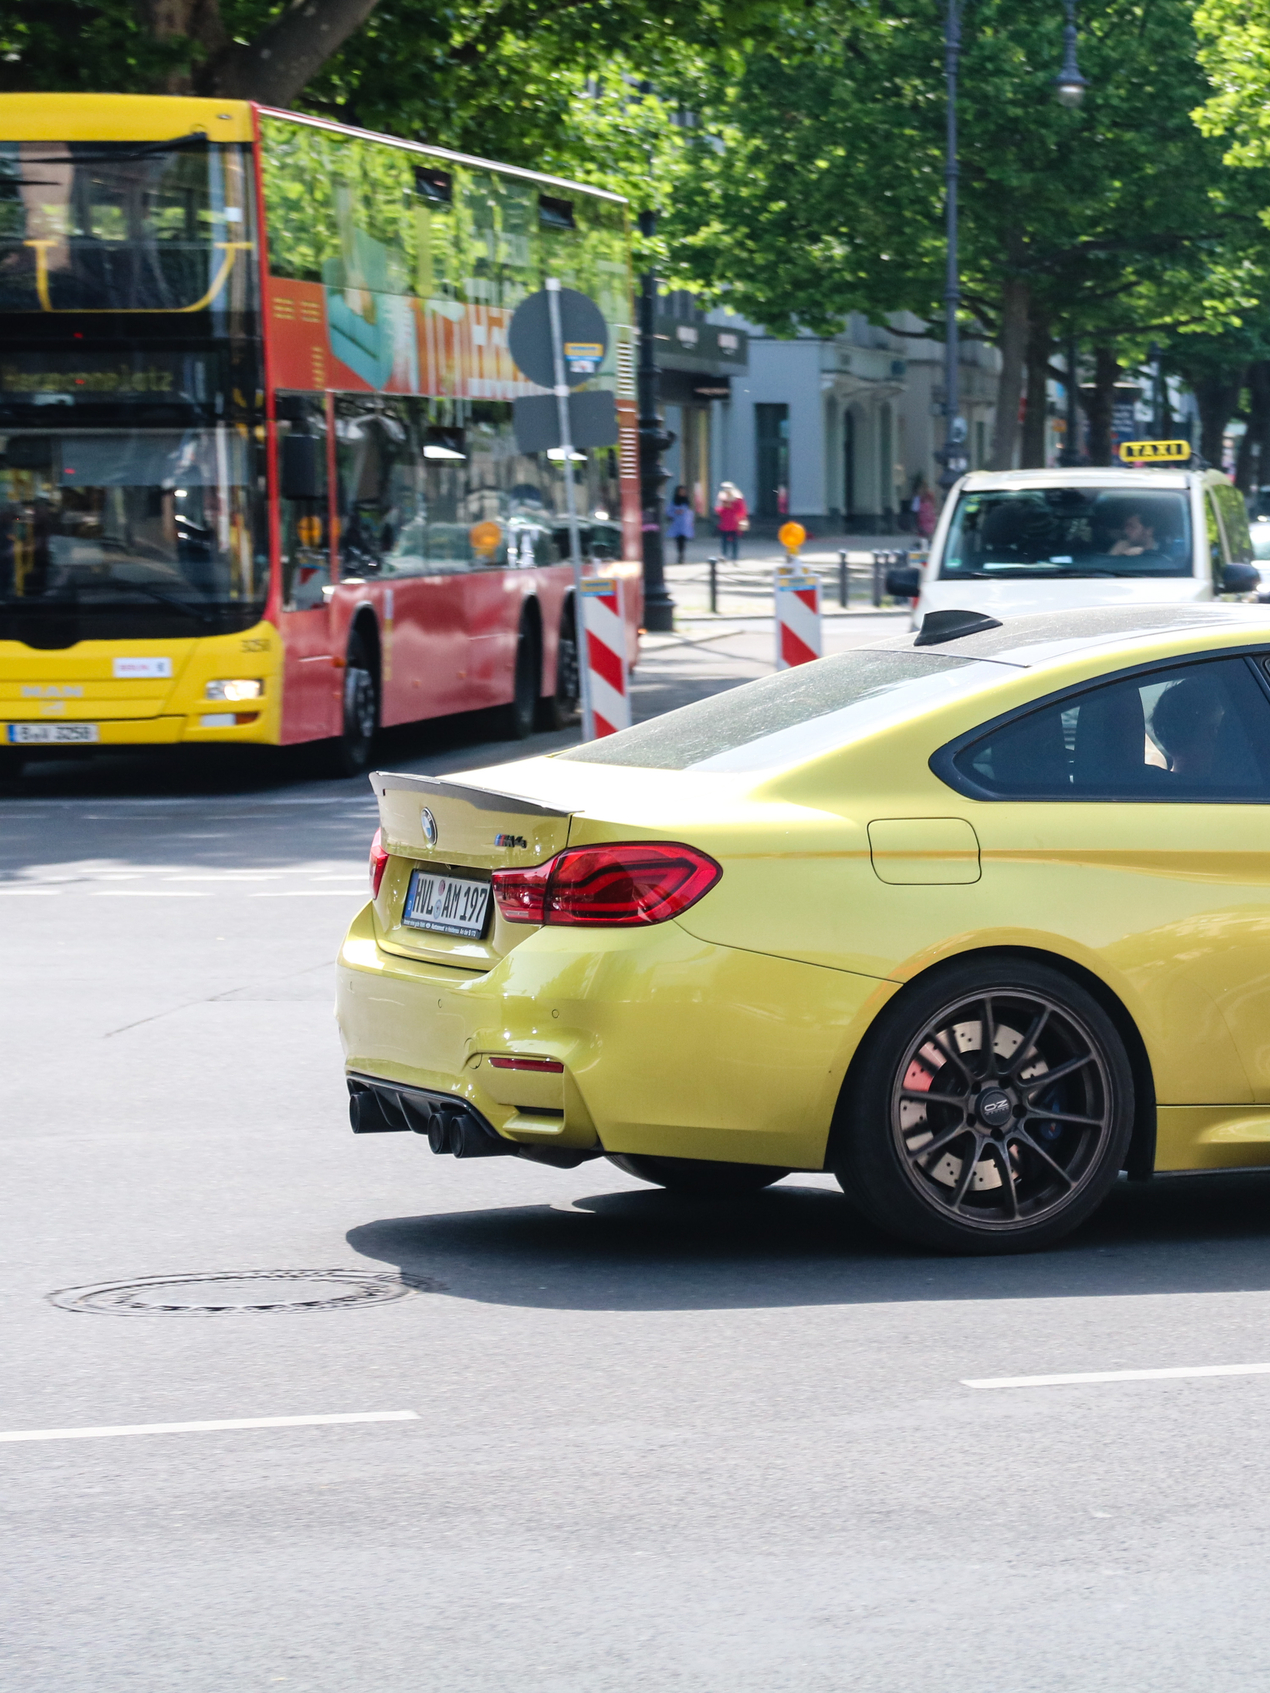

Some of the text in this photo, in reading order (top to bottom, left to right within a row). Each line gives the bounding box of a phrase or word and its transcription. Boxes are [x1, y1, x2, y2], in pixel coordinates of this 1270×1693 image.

[1131, 443, 1178, 457] TAXI
[21, 686, 83, 698] MAN
[412, 878, 488, 923] HVL AM 197
[984, 1099, 1008, 1112] OZ
